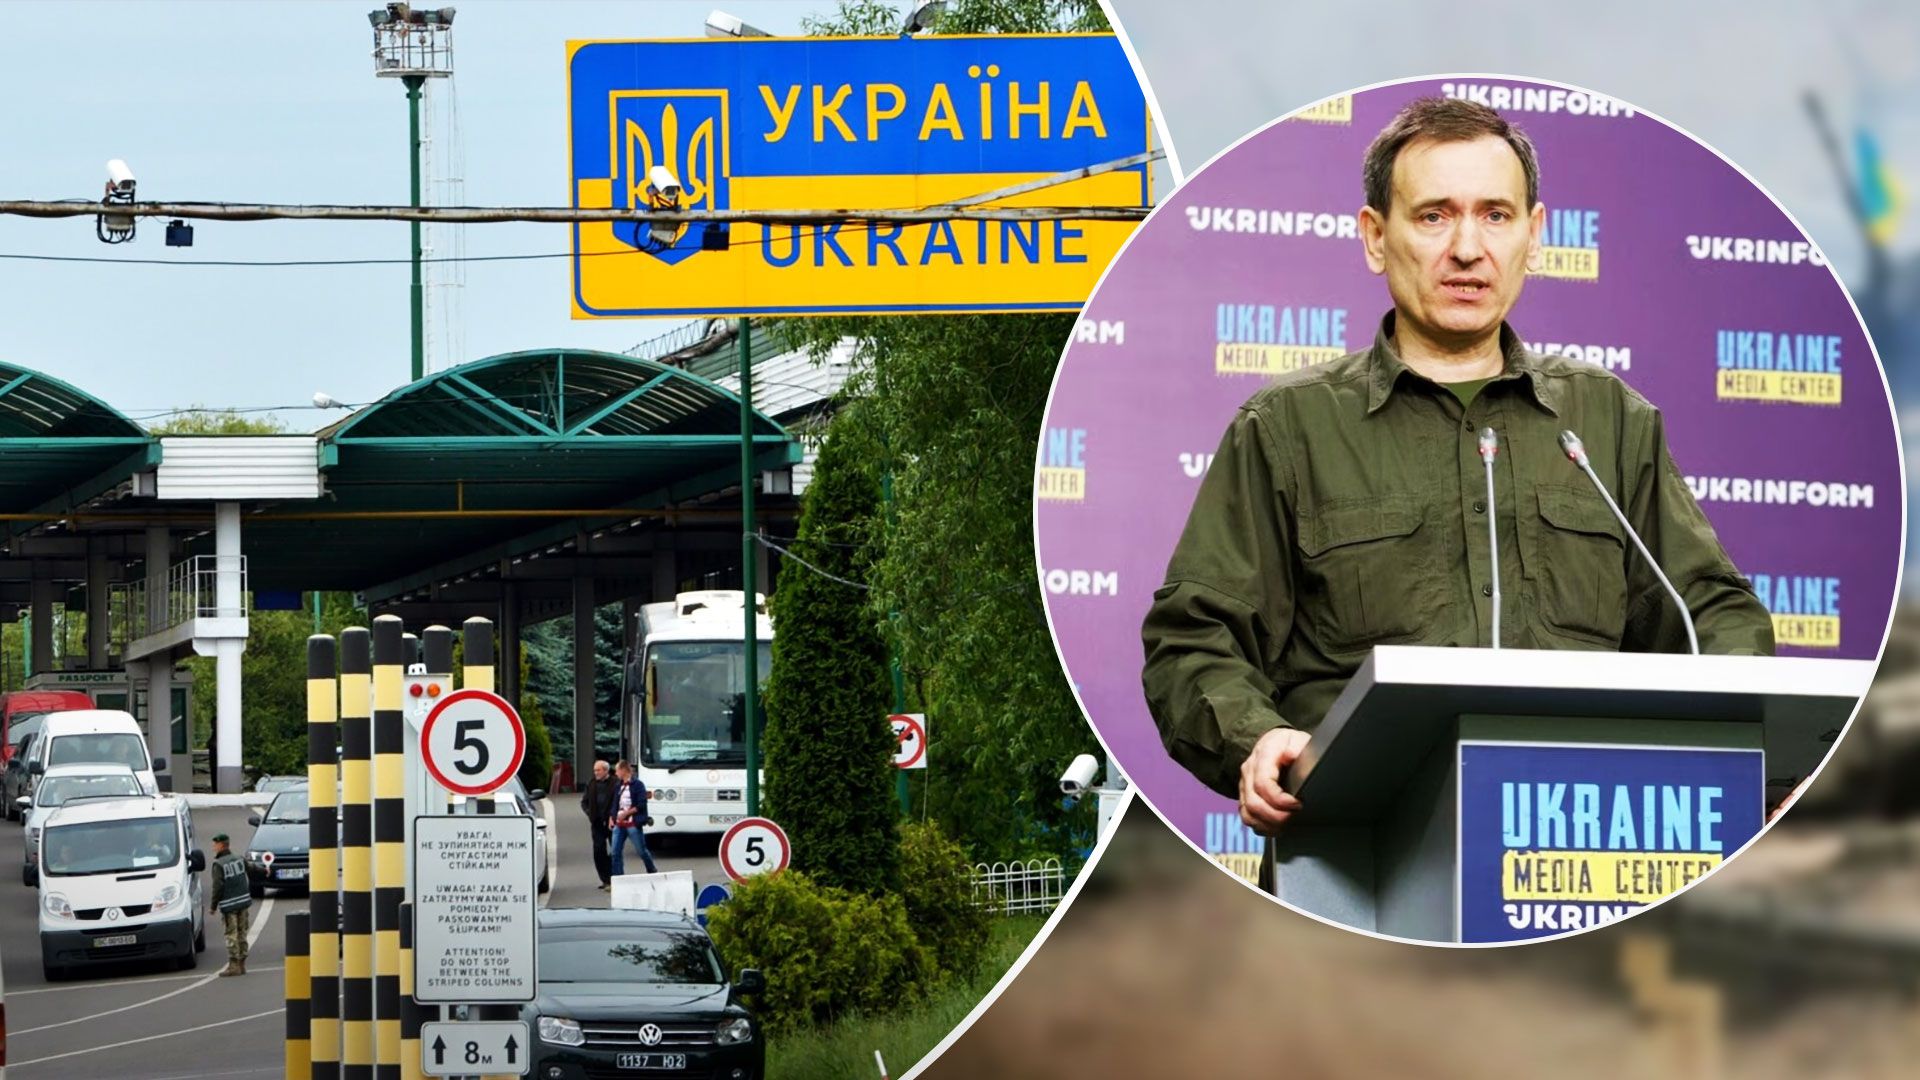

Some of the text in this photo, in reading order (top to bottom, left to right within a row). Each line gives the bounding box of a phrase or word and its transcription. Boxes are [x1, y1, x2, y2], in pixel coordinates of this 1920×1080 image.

[758, 64, 1108, 143] УКРАЇНА
[1185, 206, 1362, 239] UKRINFOR
[1540, 209, 1600, 248] AINE
[761, 220, 1088, 268] UKRAINE
[1685, 235, 1827, 266] UKRINFO
[1545, 251, 1592, 273] ENTER
[1216, 303, 1347, 347] UKRAINE
[1222, 347, 1269, 368] MEDIA
[1717, 330, 1842, 373] UKRAINE
[1723, 373, 1835, 398] MEDIA CENTER
[1683, 476, 1875, 508] UKRINFORM
[1745, 574, 1840, 615] RAINE
[1777, 619, 1834, 640] CENTER
[58, 674, 115, 682] PASSPORT
[454, 720, 489, 775] 5
[1502, 782, 1723, 851] UKRAINE
[457, 831, 492, 840] УВАГА!
[745, 837, 765, 866] 5
[448, 861, 500, 870] СТІЙКАМИ
[1513, 857, 1593, 894] MEDIA
[422, 895, 508, 903] ZATRZYMYWANIA
[436, 885, 513, 893] UWAGA! ZAKAZ
[438, 915, 512, 923] PASKOWANYMI
[440, 958, 510, 966] DO NOT STOP
[445, 948, 505, 956] ATTENTION!
[428, 979, 523, 987] STRIPED COLUMNS
[439, 968, 511, 976] BETWEEN THE
[621, 1055, 649, 1067] 1137
